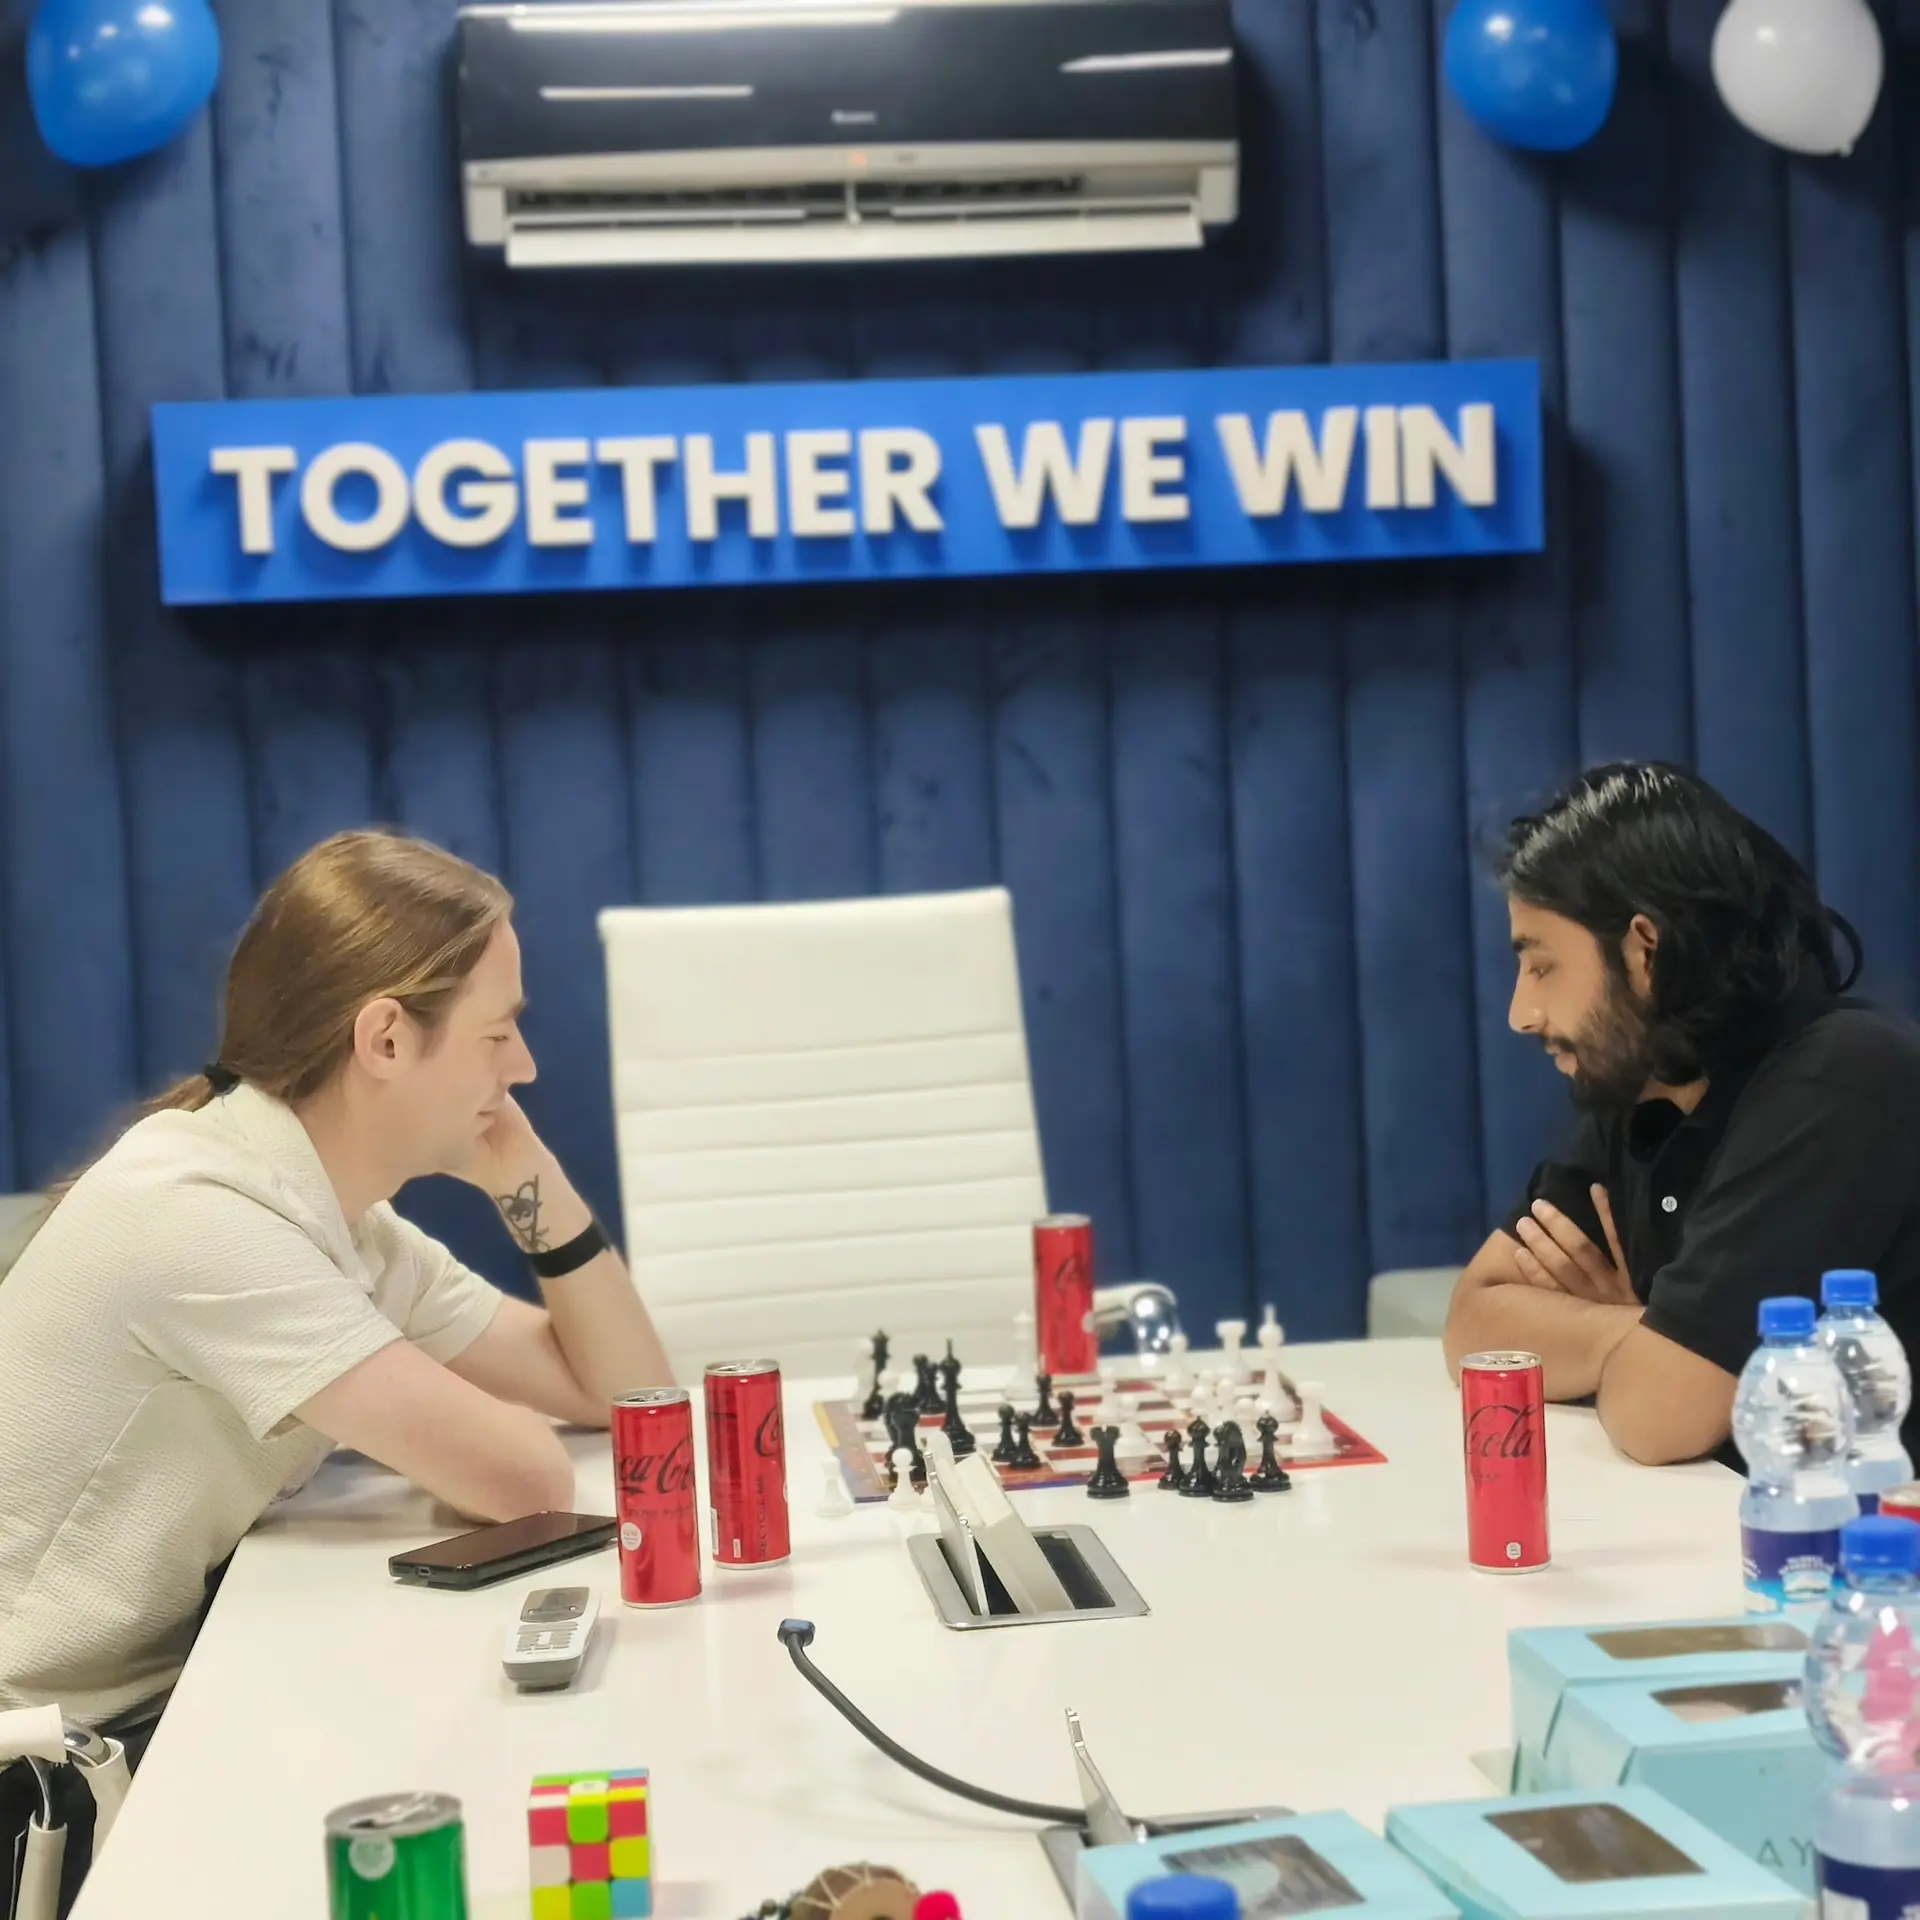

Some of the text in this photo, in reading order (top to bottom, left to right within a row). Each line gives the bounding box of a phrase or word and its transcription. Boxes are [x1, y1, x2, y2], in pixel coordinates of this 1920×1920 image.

[211, 404, 1494, 553] TOGETHER WE WIN
